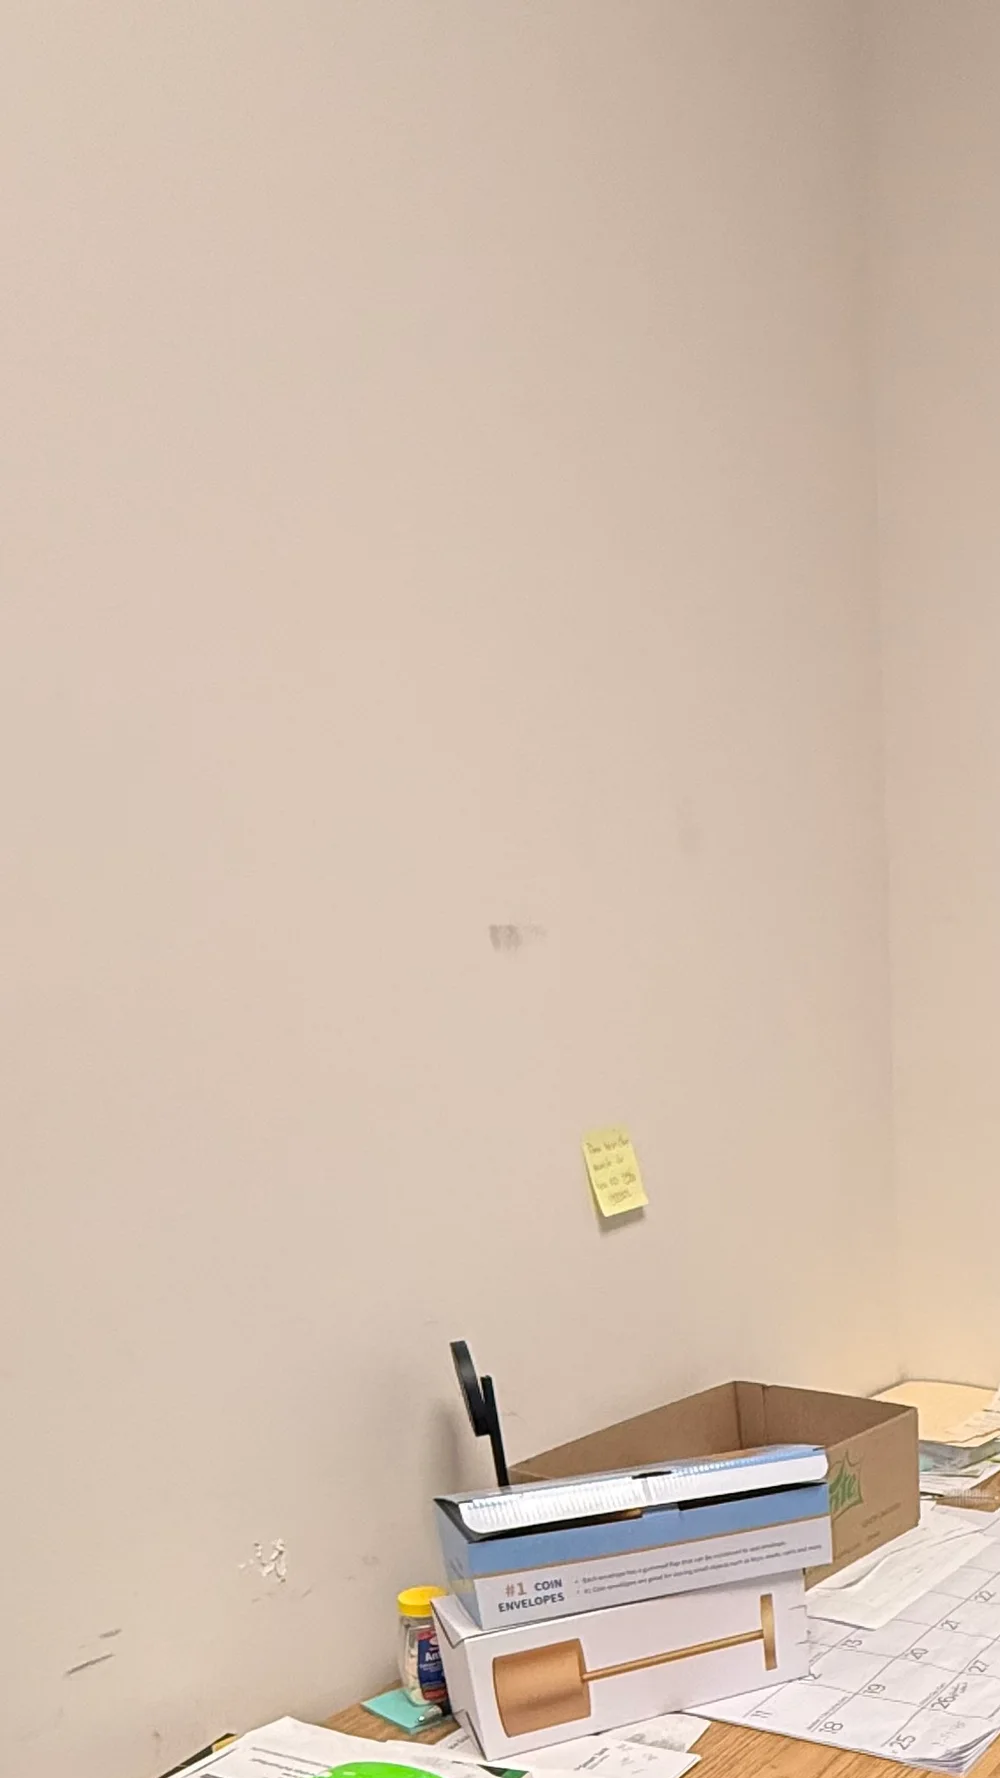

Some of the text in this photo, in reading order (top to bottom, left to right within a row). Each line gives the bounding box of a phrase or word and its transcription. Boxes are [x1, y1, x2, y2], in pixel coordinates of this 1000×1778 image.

[505, 1578, 562, 1597] #1 COIN
[498, 1592, 565, 1613] ENVELOPES
[968, 1659, 990, 1674] 27
[863, 1683, 886, 1695] 19
[819, 1721, 844, 1734] 18
[889, 1734, 916, 1750] 25
